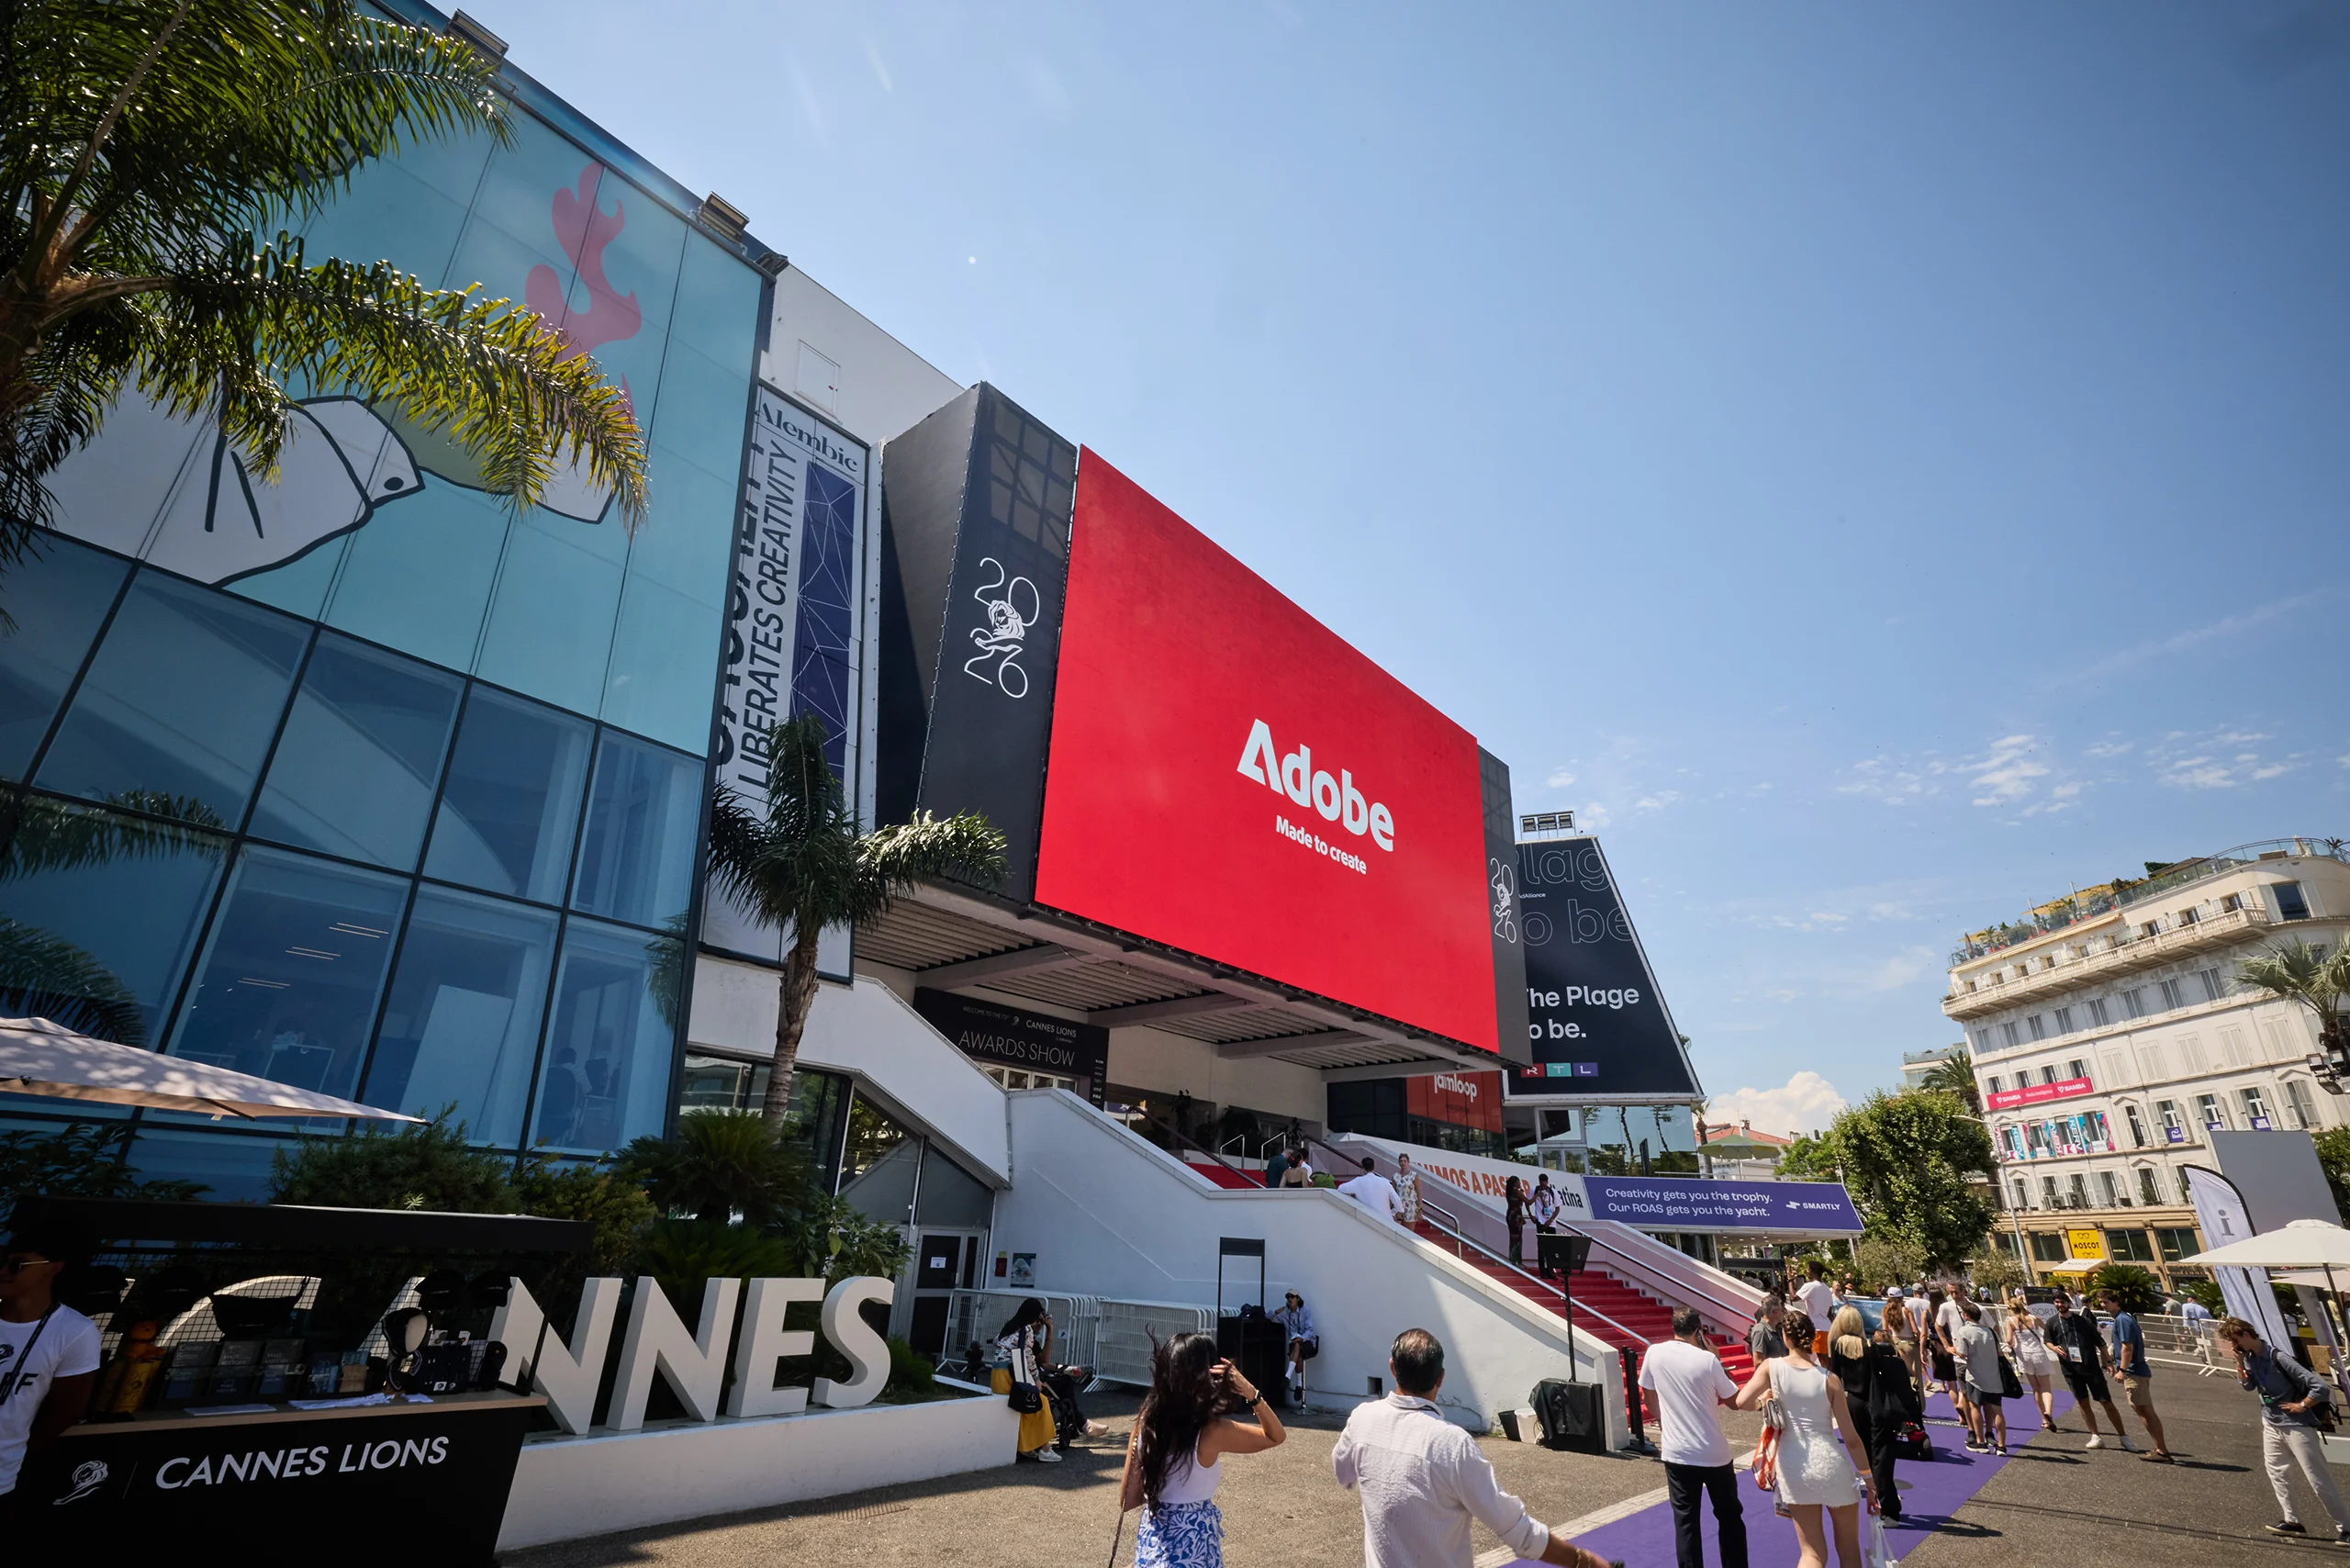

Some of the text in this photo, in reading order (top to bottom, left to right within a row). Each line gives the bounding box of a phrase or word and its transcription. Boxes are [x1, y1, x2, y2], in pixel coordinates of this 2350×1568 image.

[755, 401, 858, 472] Alembic
[759, 439, 798, 606] CREATIVITY
[974, 557, 1040, 626] 20
[737, 606, 785, 790] LIBERATES
[1237, 718, 1394, 852] Adobe
[1276, 815, 1367, 875] Made to create
[1516, 843, 1611, 891] lag
[1528, 985, 1639, 1010] he Plage
[1025, 1019, 1077, 1038] CANNES LIONS
[1549, 1018, 1587, 1039] be.
[958, 1030, 1075, 1067] AWARDS SHOW
[2002, 1093, 2021, 1103] SAMBA
[2065, 1082, 2087, 1092] SAMBA
[2070, 1119, 2084, 1151] KERV
[1471, 1171, 1483, 1194] A
[1606, 1188, 1773, 1203] Creativity gets you the trophy.
[1608, 1203, 1770, 1217] Our ROAS gets you the yacht.
[1803, 1202, 1841, 1210] SMARTLY
[155, 1436, 449, 1490] CANNES LIONS
